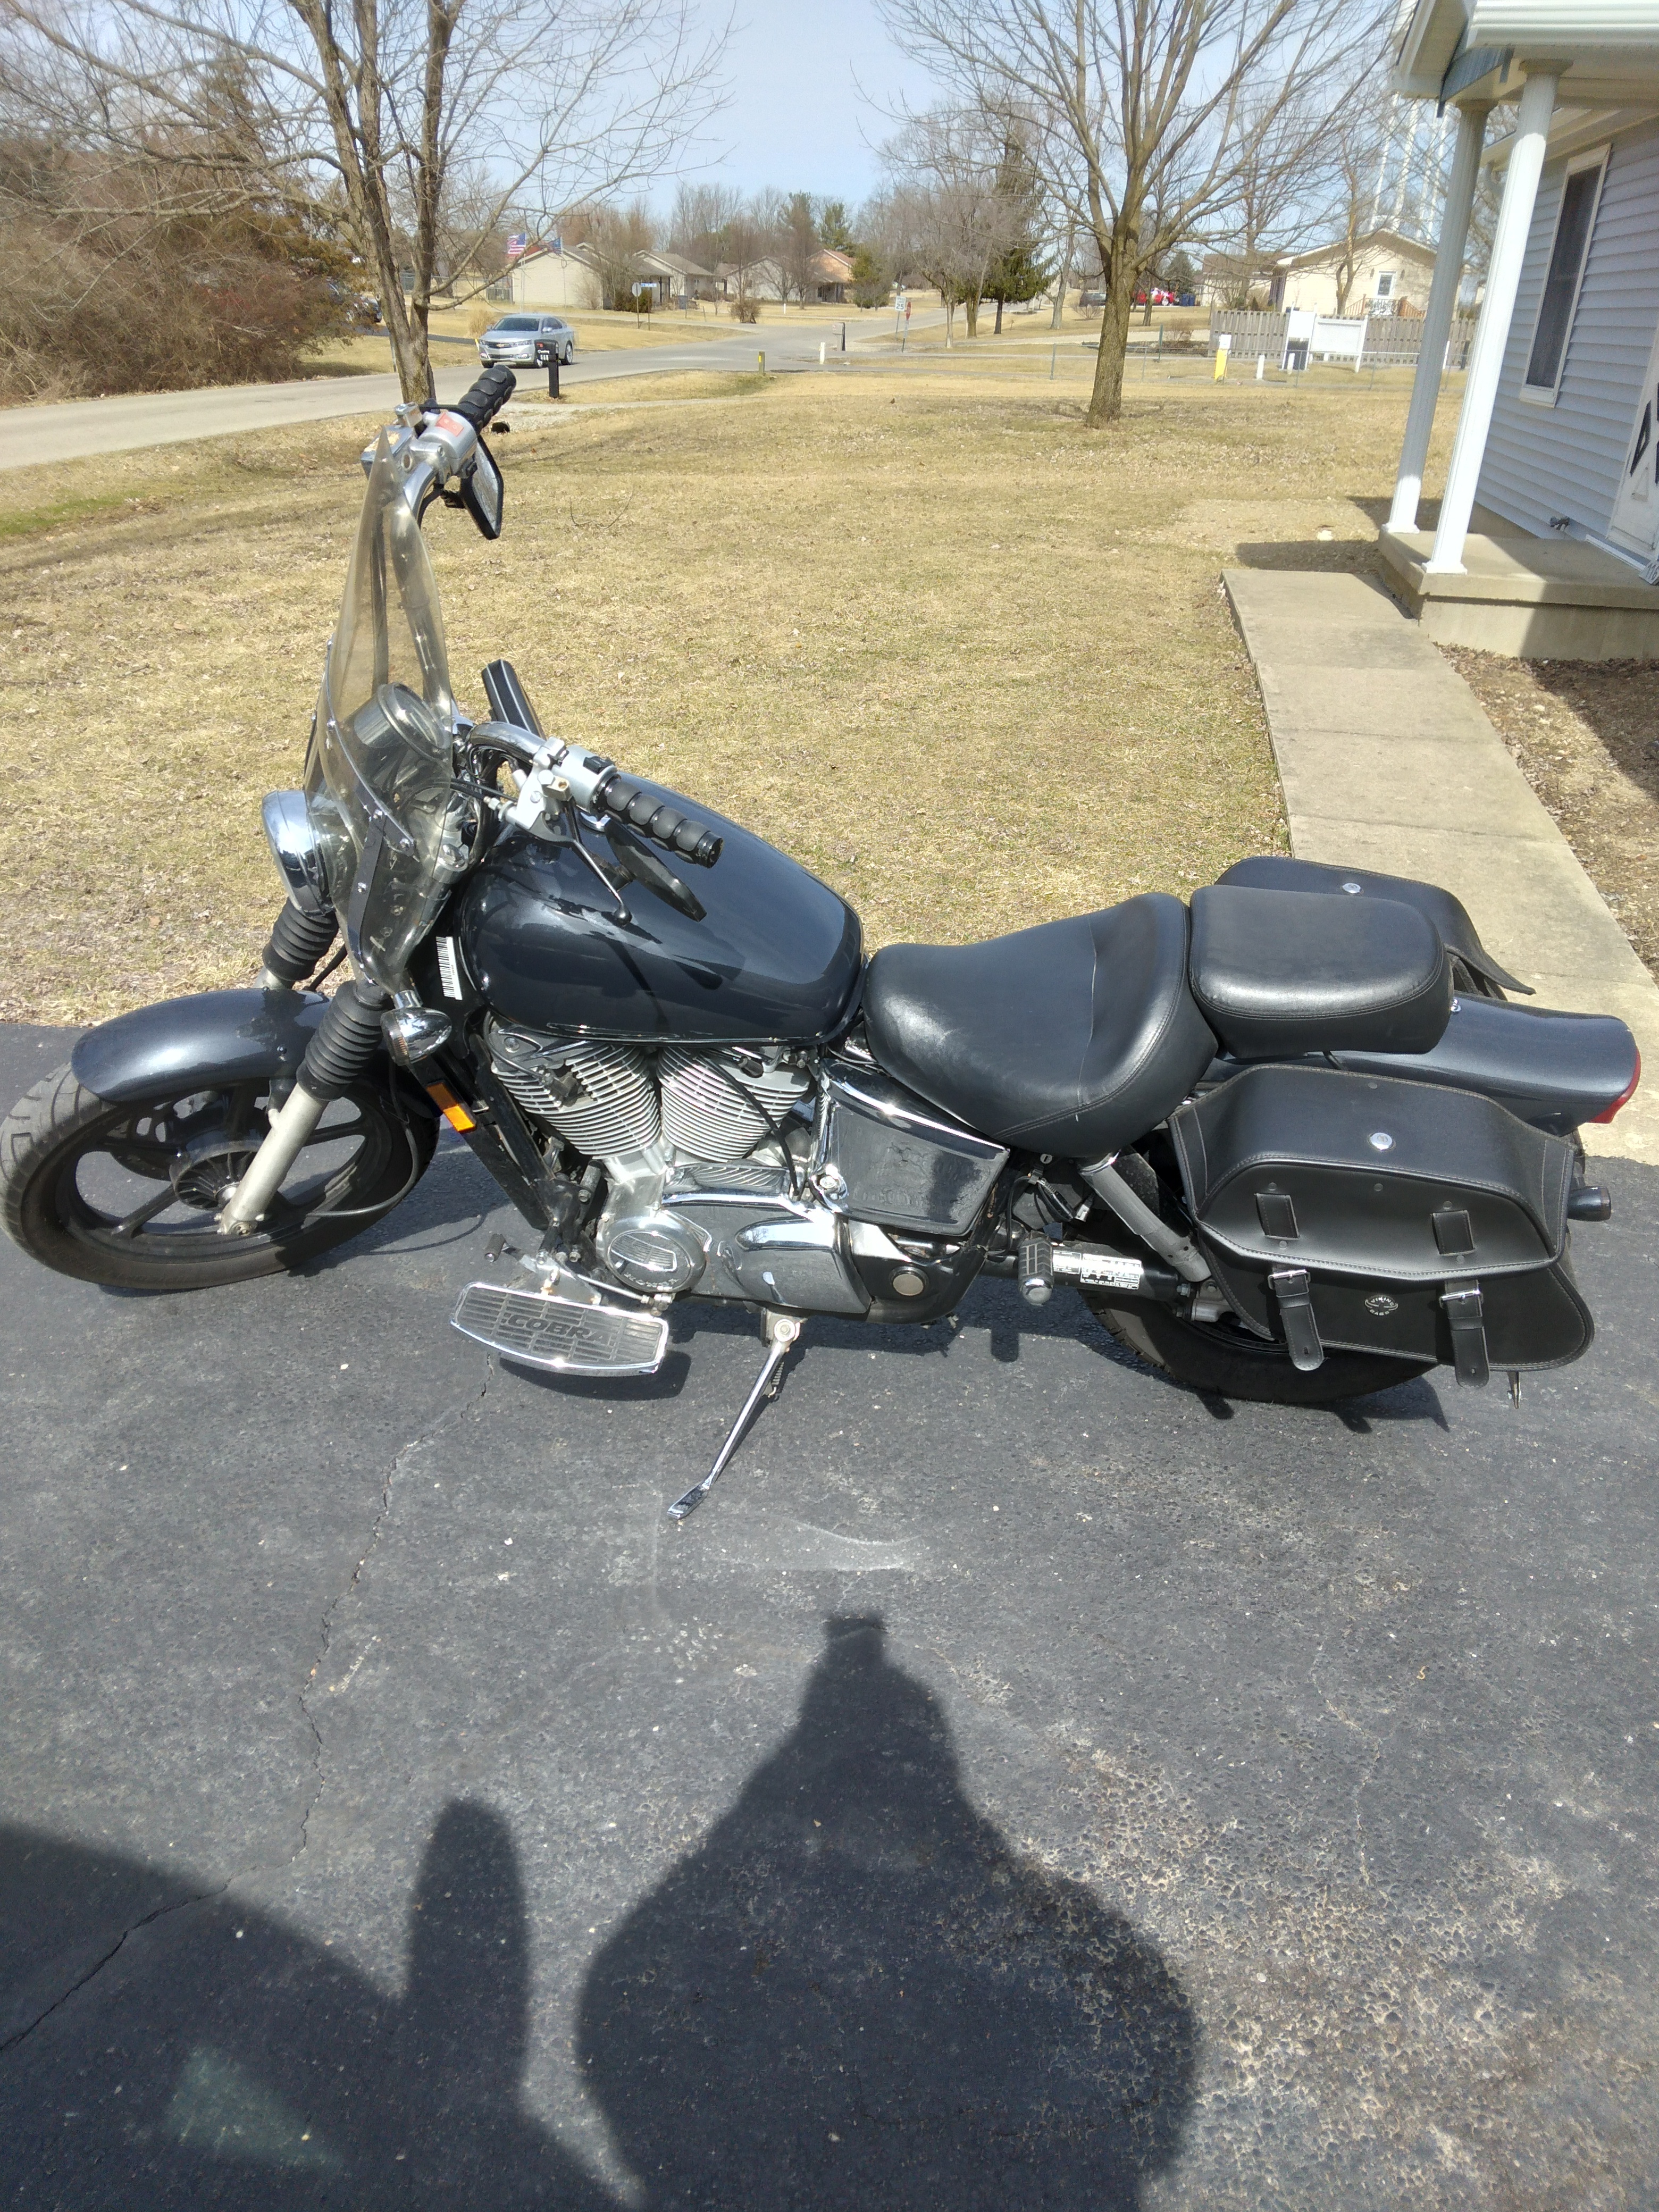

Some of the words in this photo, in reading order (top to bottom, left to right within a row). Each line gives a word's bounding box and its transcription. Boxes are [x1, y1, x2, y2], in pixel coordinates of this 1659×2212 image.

[624, 1272, 679, 1288] HONDA
[1370, 1296, 1394, 1306] VIKING
[508, 1314, 610, 1345] COBRA
